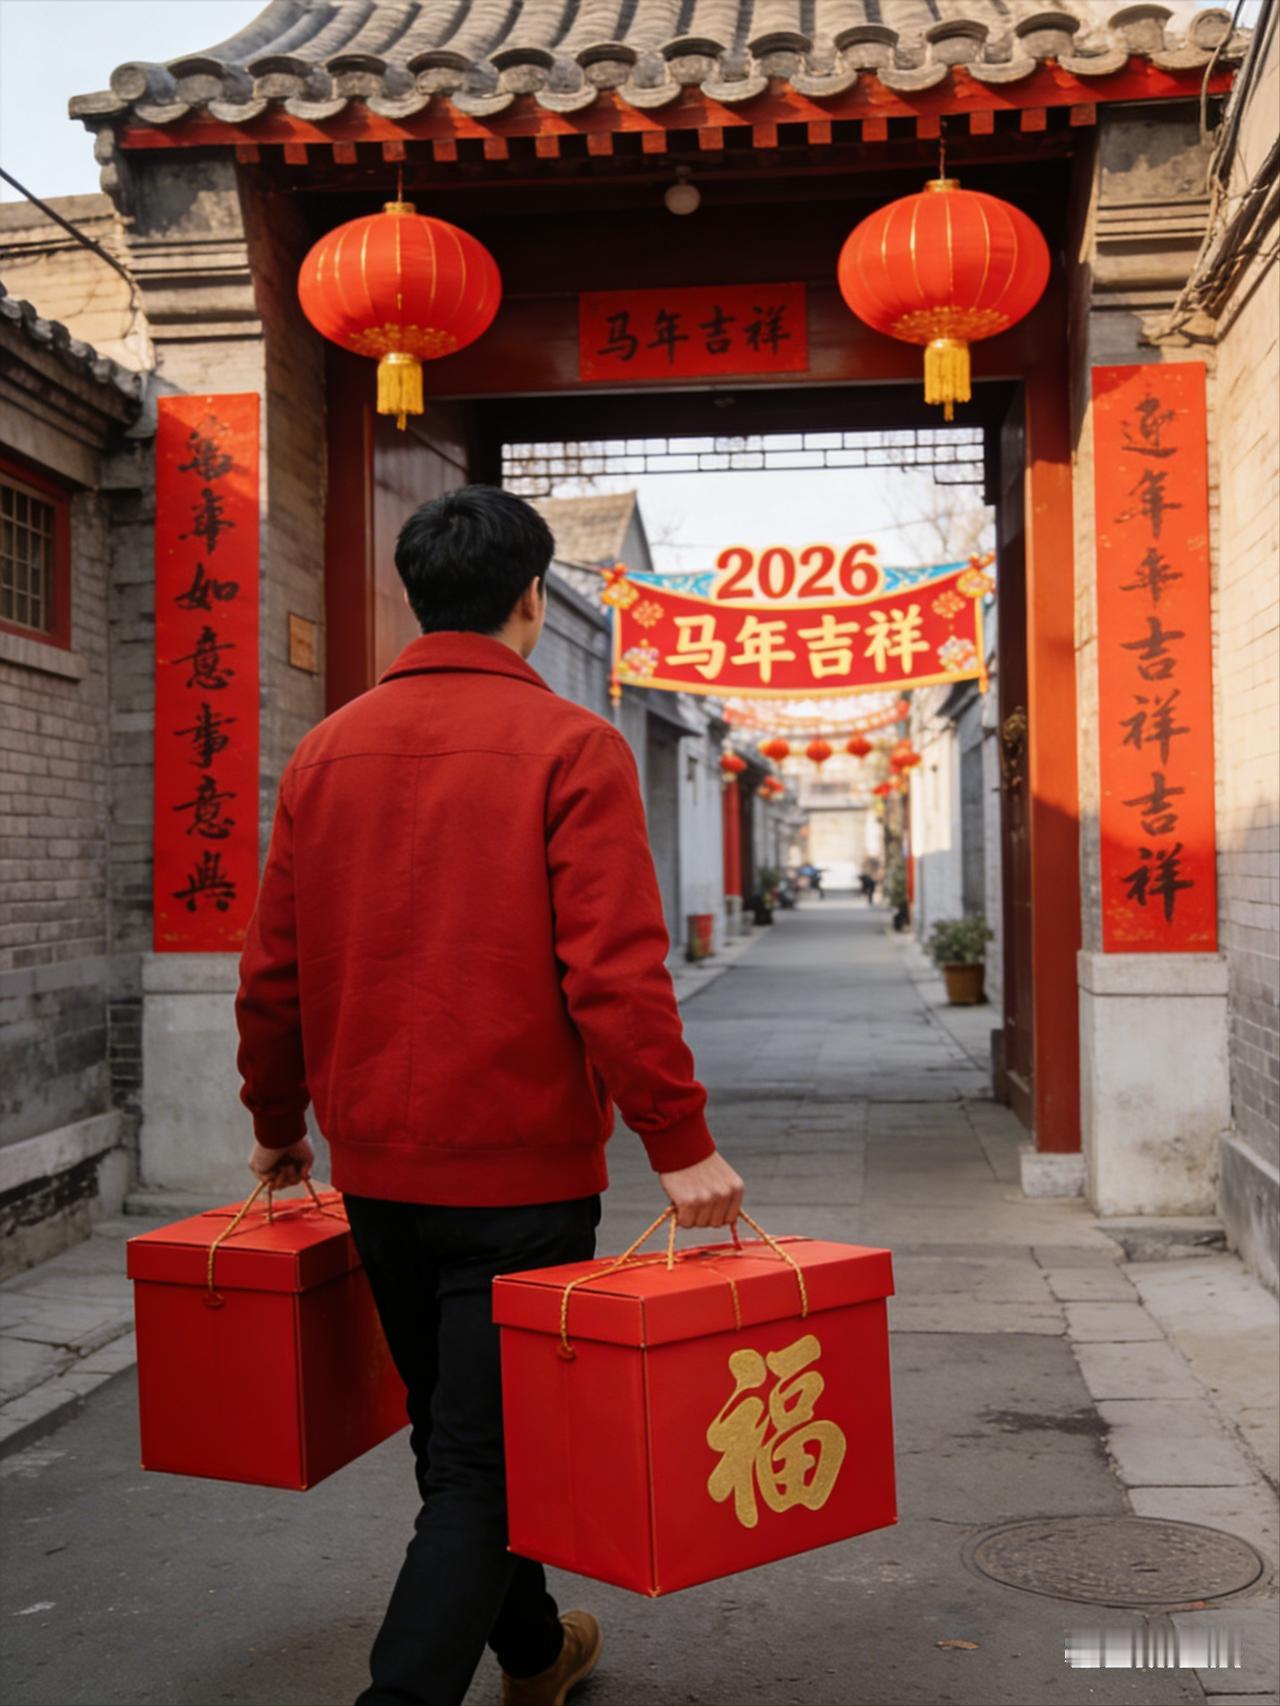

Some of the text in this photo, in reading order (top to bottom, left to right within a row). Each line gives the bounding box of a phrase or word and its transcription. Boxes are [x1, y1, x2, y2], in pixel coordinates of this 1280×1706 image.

[597, 305, 790, 363] 马年吉祥
[715, 542, 881, 600] 2026
[664, 604, 931, 683] 马年吉祥
[706, 1333, 847, 1529] 福
